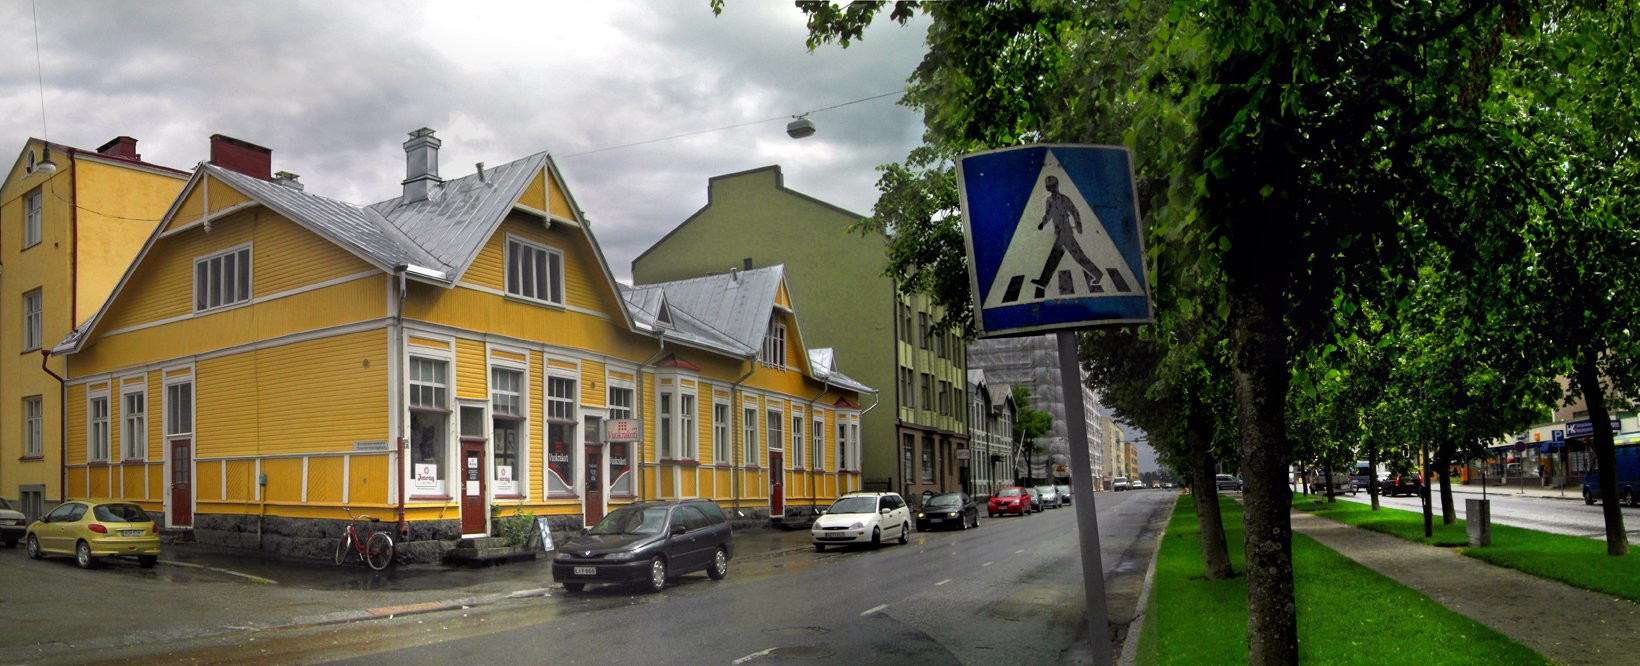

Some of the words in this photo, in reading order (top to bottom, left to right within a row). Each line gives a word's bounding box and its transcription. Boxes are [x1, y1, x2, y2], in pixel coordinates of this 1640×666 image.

[1566, 424, 1576, 434] HK
[607, 430, 638, 439] Vuokrakoti
[1555, 431, 1562, 441] P
